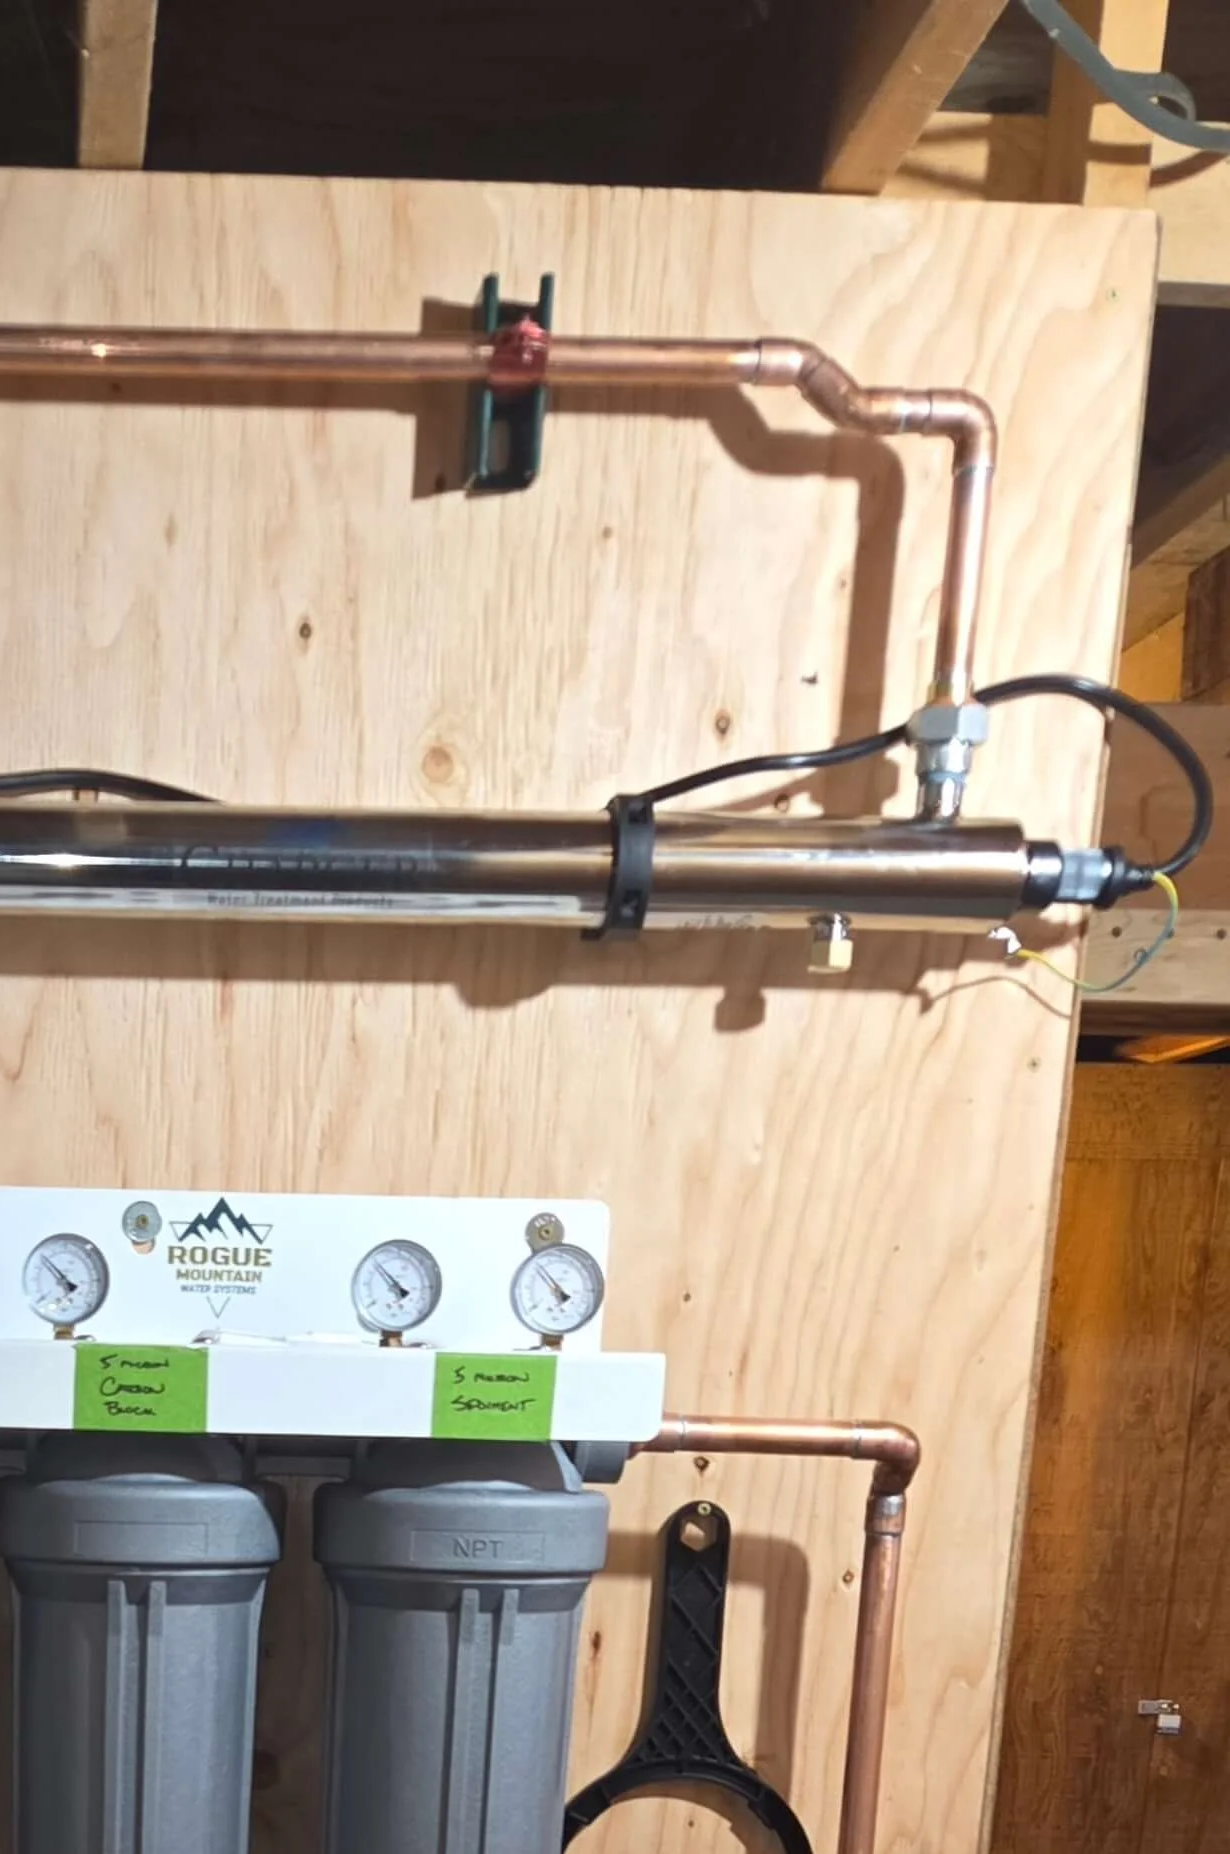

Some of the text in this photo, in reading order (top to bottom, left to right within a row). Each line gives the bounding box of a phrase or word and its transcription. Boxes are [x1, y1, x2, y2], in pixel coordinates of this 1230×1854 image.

[168, 1245, 272, 1267] ROGUE
[176, 1268, 263, 1283] MOUNTAIN
[180, 1284, 257, 1295] WATER SYSTEMS
[98, 1353, 119, 1370] 5
[452, 1365, 466, 1385] 5
[452, 1537, 505, 1559] NPT
